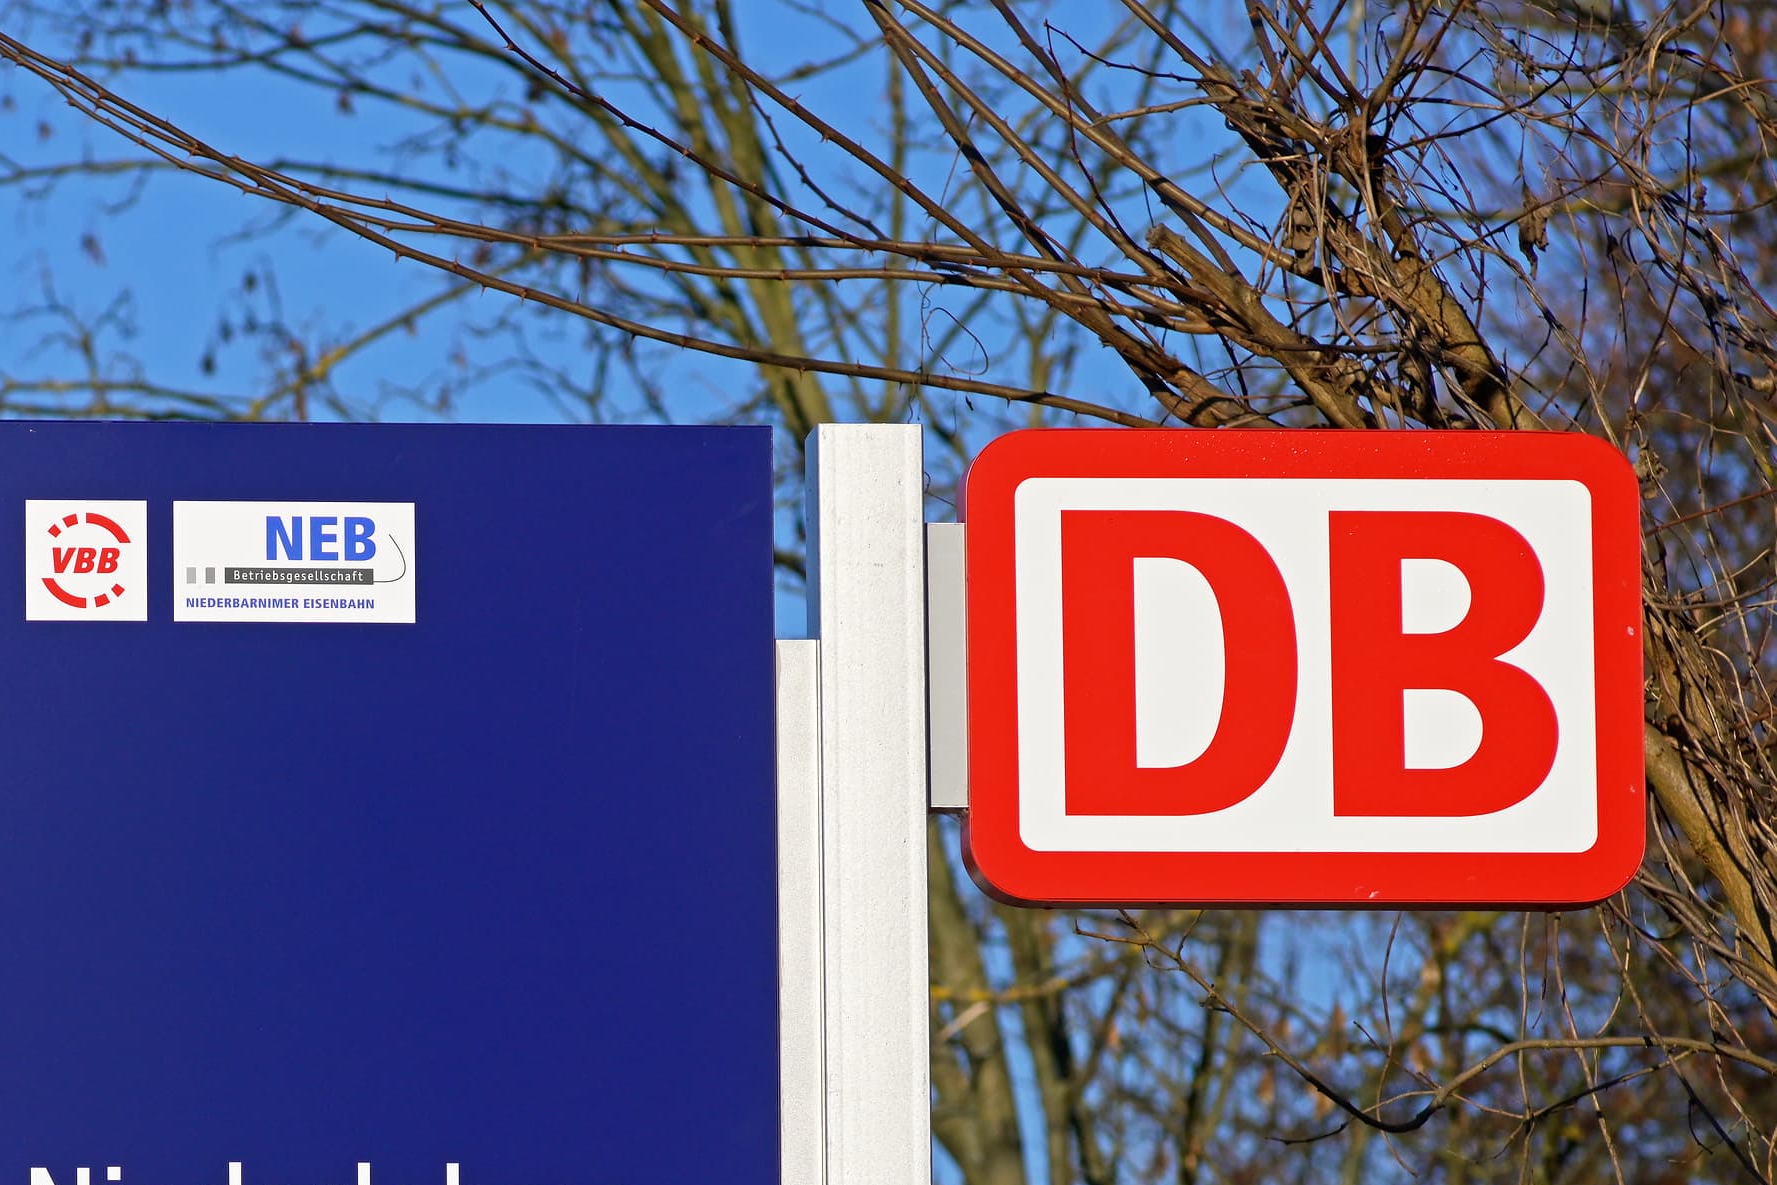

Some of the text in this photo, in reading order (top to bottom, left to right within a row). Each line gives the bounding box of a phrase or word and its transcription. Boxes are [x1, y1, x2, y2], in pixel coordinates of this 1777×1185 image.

[265, 515, 377, 562] NEB
[51, 547, 121, 574] VBB
[232, 569, 365, 583] Betriebsgesellschaft
[185, 597, 376, 610] NIEDERBARNIMER EISENBAHN
[1060, 509, 1559, 818] DB
